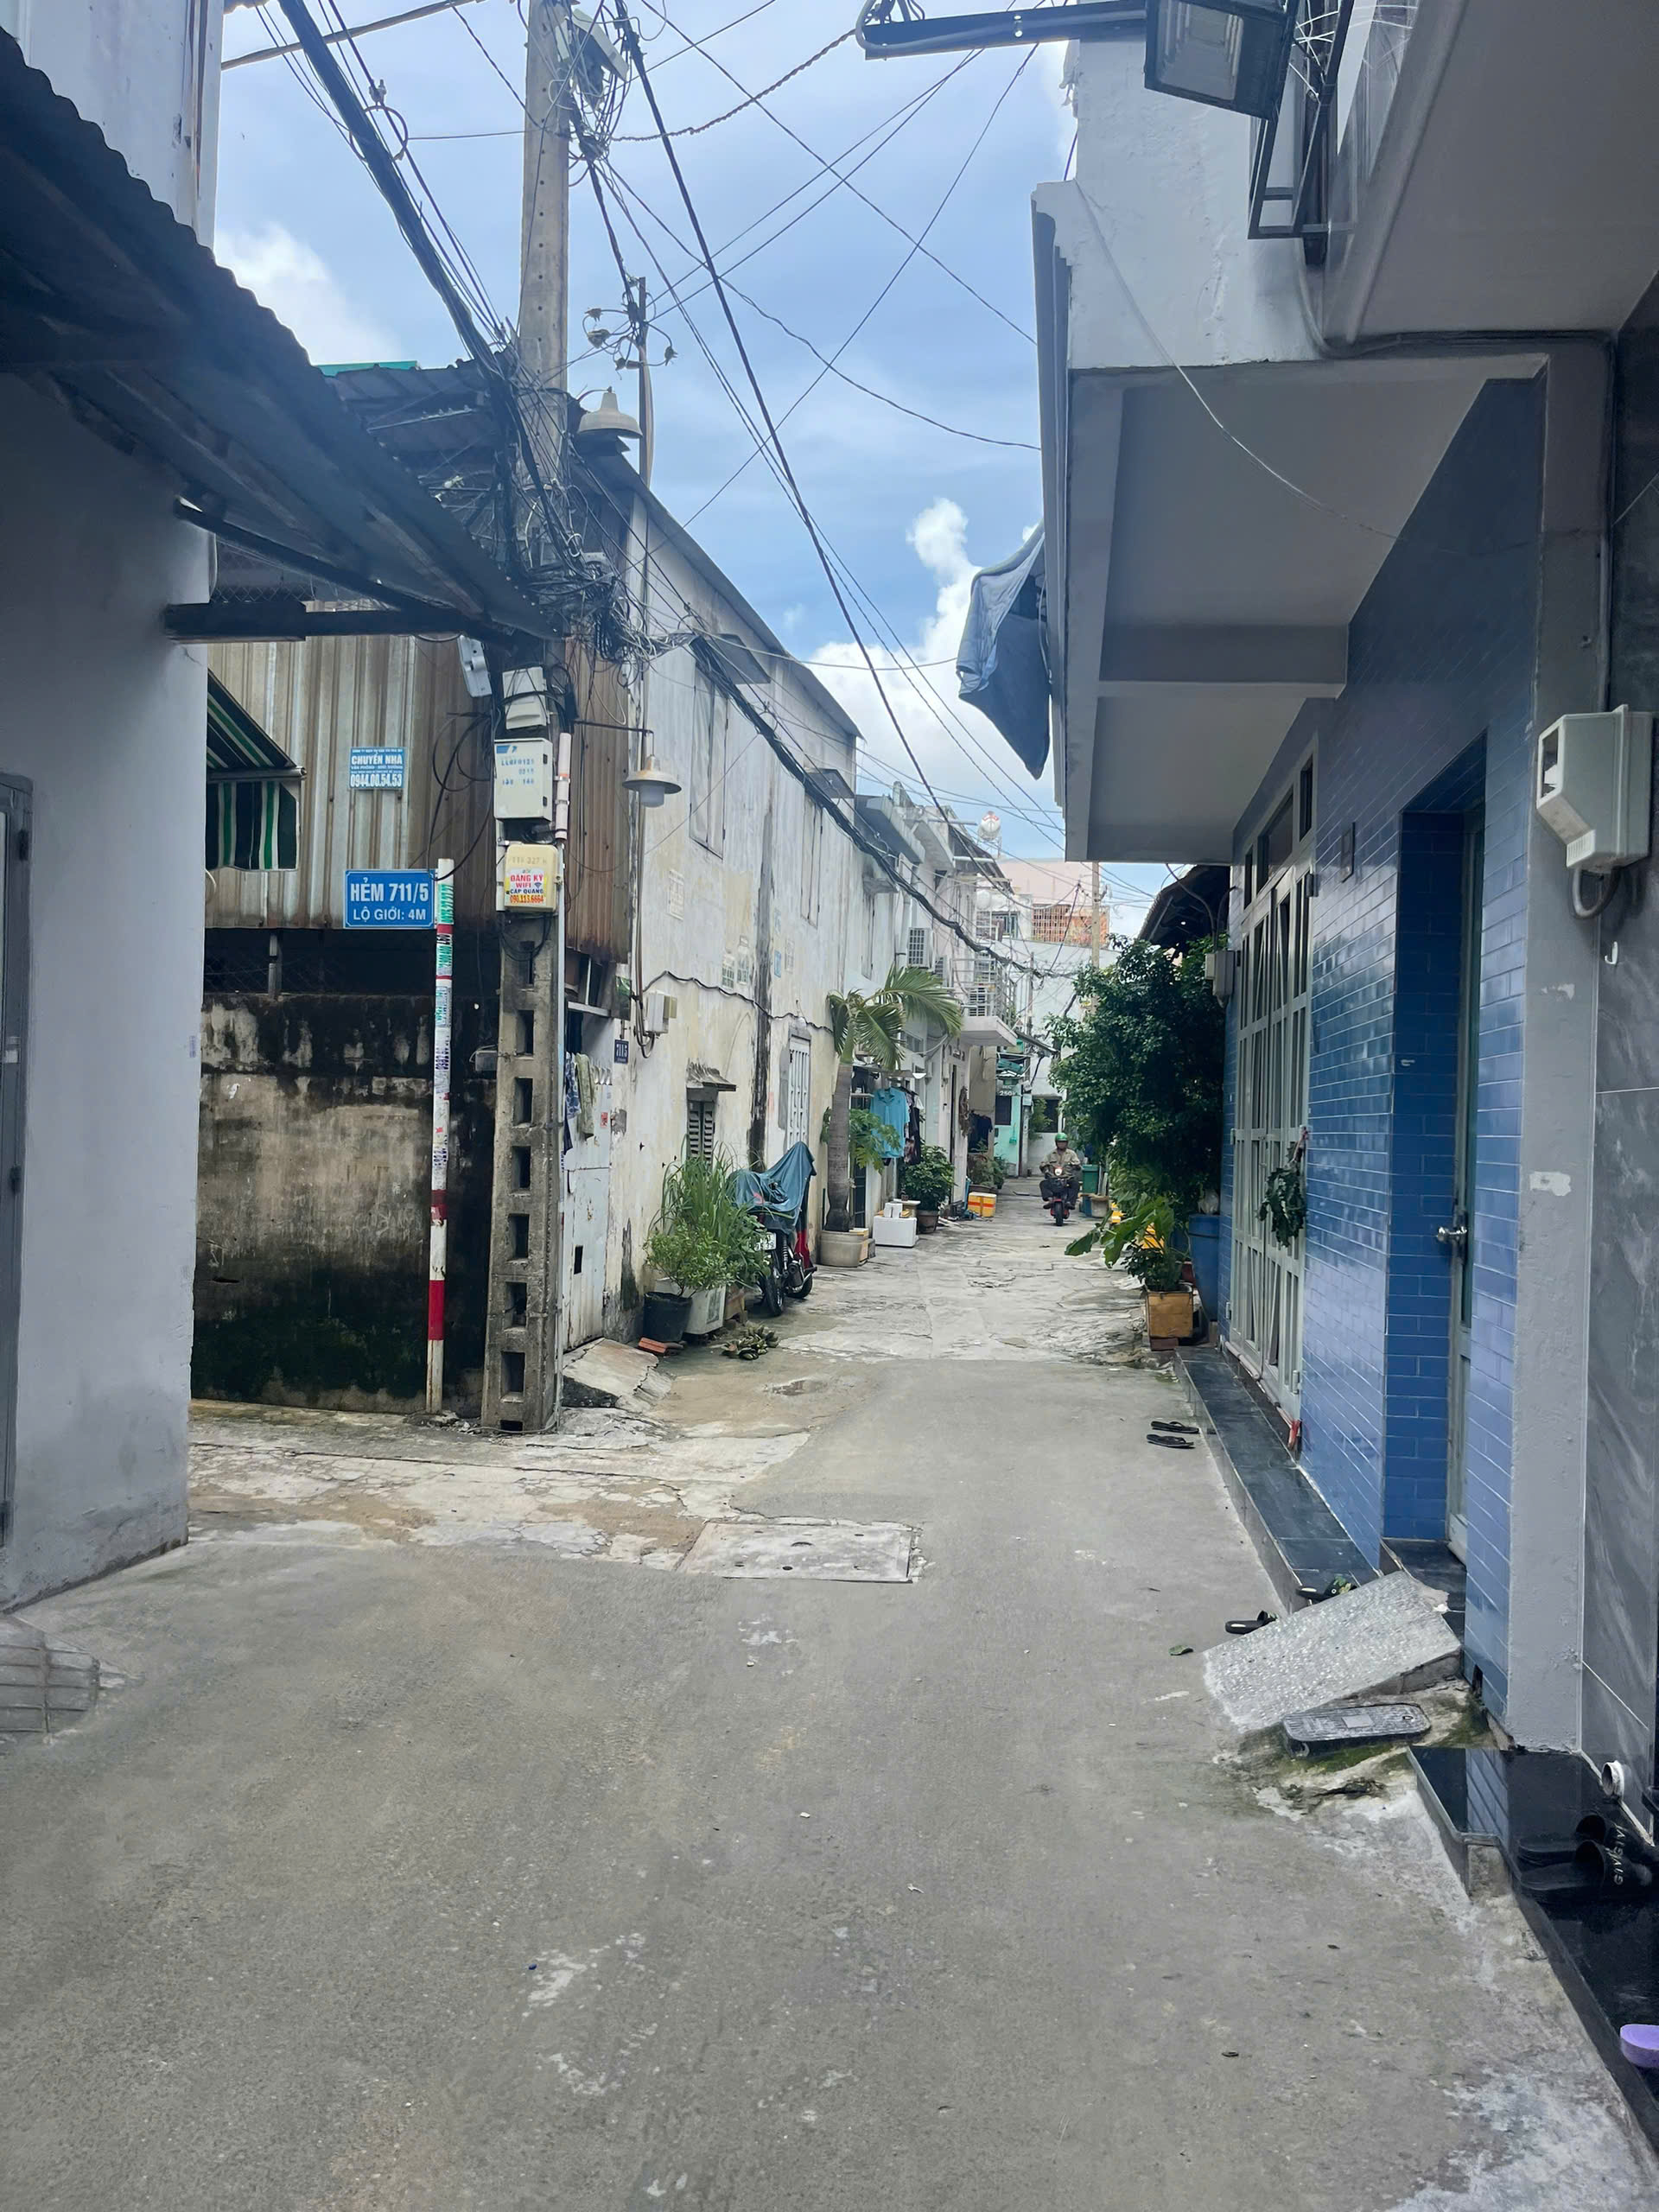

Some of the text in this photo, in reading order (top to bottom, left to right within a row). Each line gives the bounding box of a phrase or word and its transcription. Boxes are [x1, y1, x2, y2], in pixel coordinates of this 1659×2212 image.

[352, 752, 383, 765] CHUYỂN
[350, 877, 429, 904] HẺM 711/5
[353, 906, 426, 923] LỘ GIỚI: 4M
